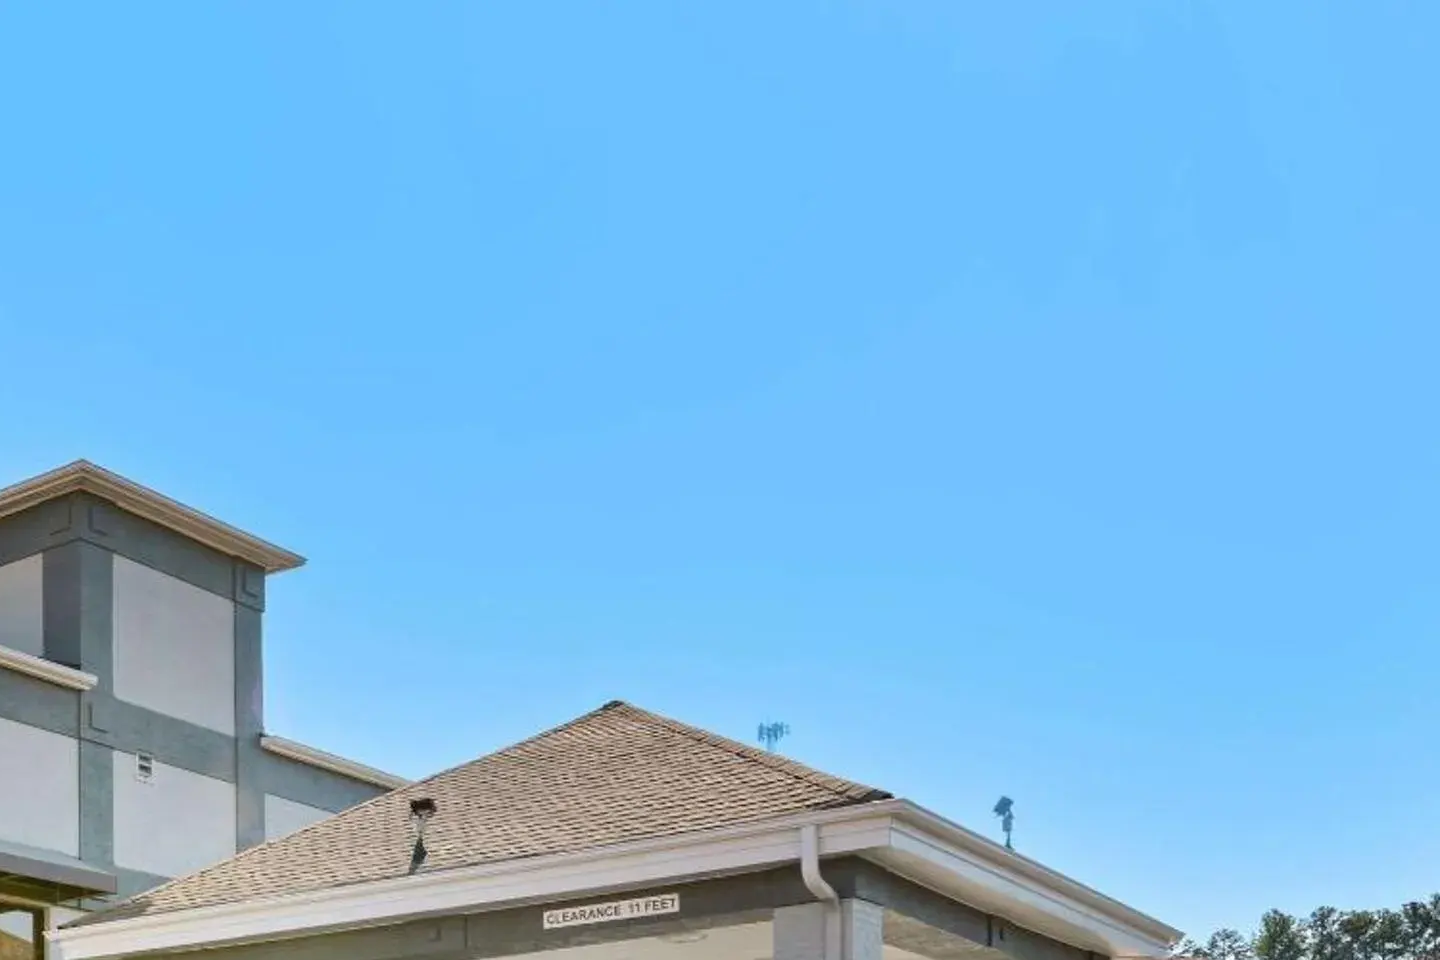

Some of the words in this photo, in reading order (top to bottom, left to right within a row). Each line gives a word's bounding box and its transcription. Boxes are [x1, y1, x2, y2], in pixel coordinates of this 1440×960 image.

[546, 903, 622, 924] CLEARANCE
[628, 901, 642, 913] 11
[644, 897, 676, 912] FEET
